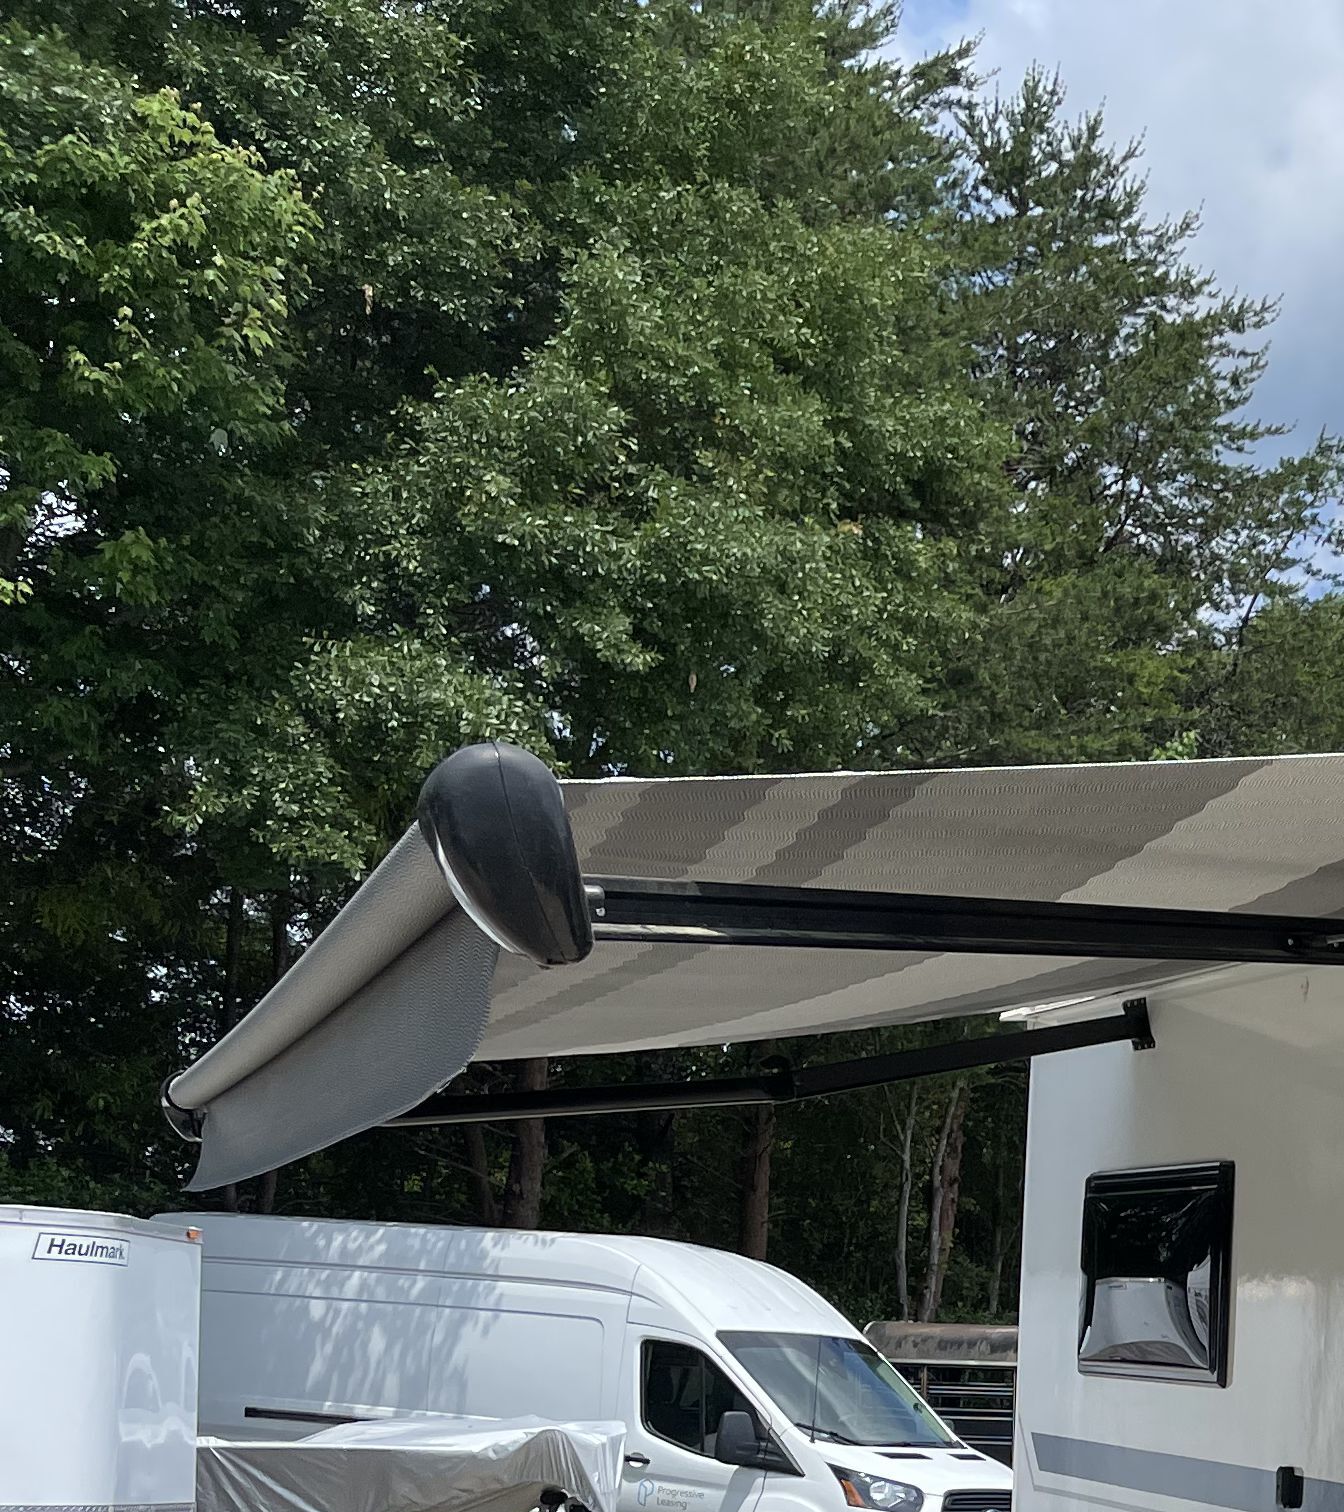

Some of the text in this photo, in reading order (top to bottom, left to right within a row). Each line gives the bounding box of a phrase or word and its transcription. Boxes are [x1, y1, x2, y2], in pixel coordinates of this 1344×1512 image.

[46, 1237, 125, 1260] Haulmark
[657, 1485, 705, 1500] Progressive
[656, 1496, 688, 1511] Leasing
